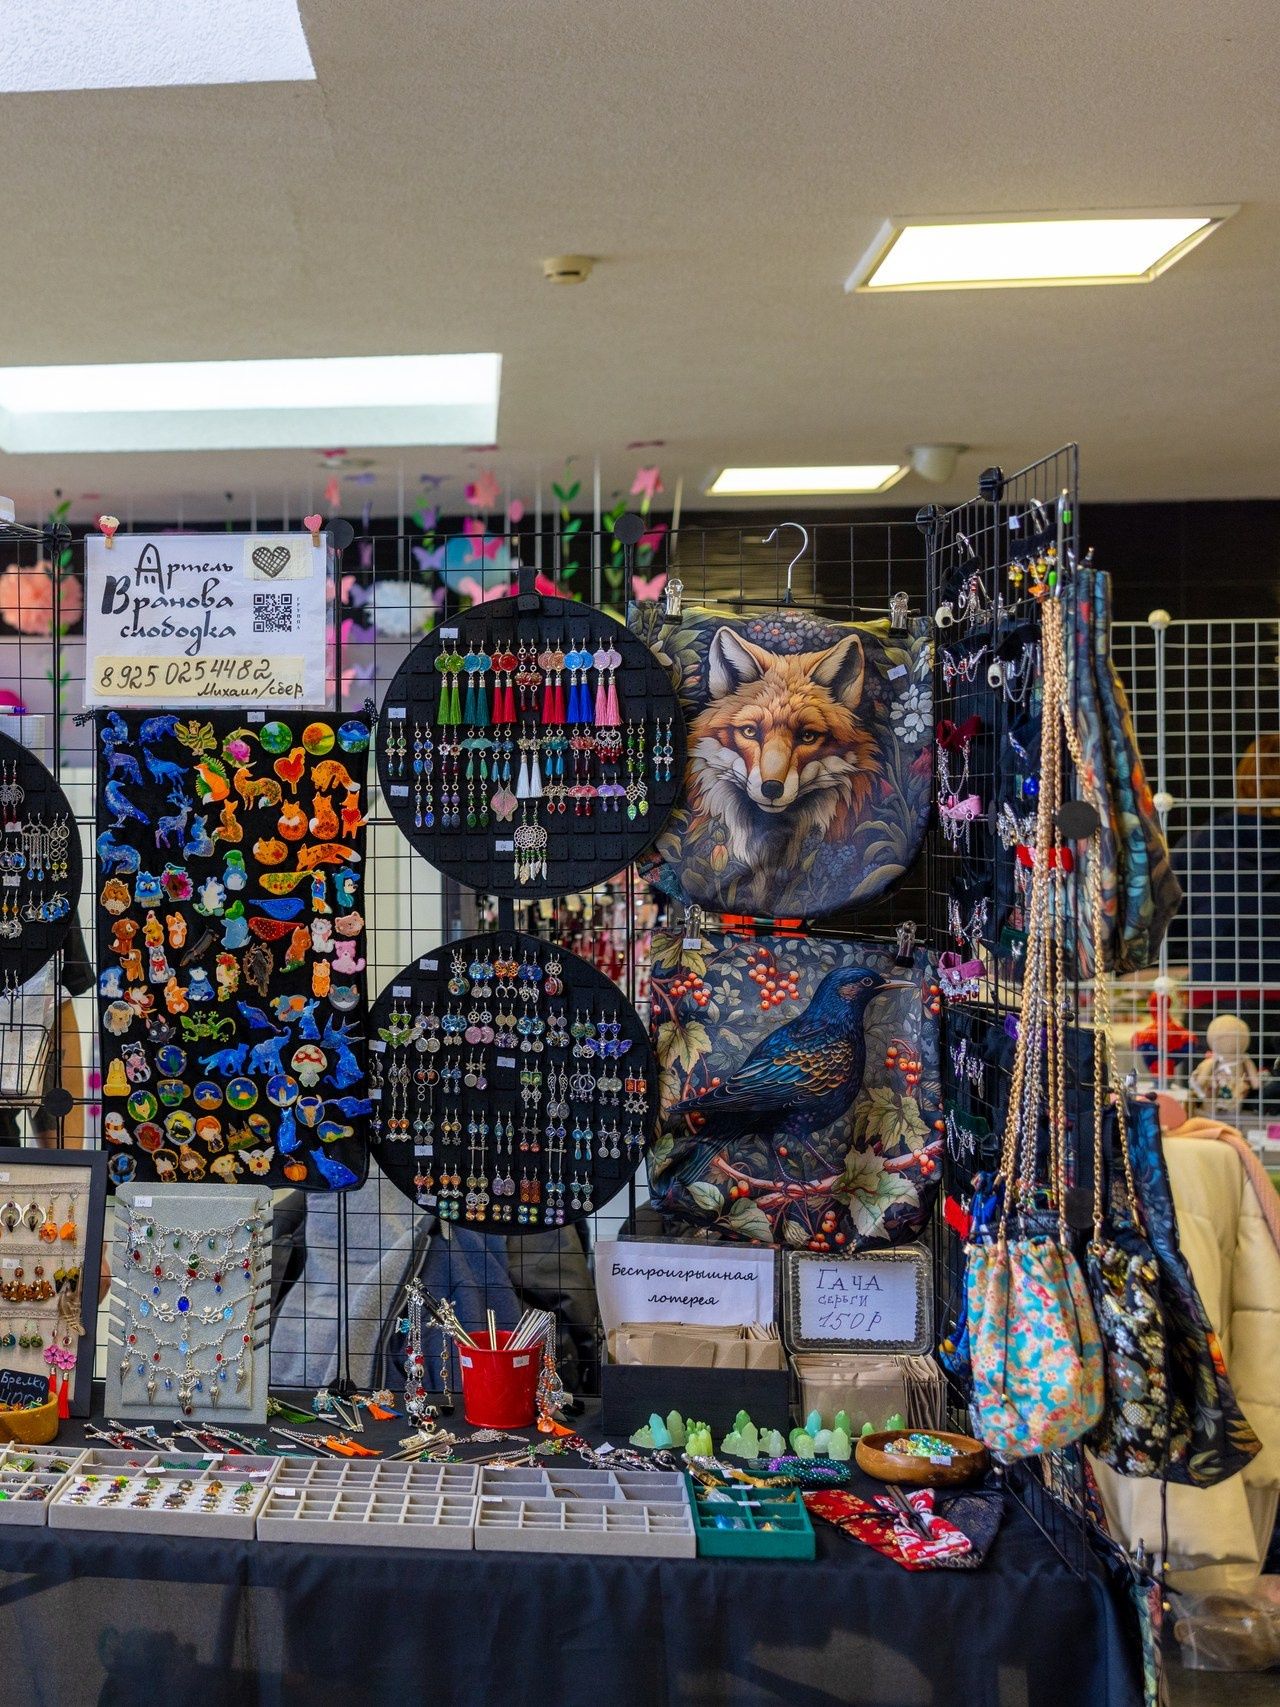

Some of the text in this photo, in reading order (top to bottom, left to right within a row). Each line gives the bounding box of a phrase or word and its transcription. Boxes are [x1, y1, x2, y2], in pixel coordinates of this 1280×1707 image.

[134, 543, 234, 595] Артель
[101, 575, 234, 631] Вранова
[120, 610, 237, 656] слободка
[611, 1263, 759, 1282] Беспроигрышная
[648, 1294, 719, 1308] лотерея
